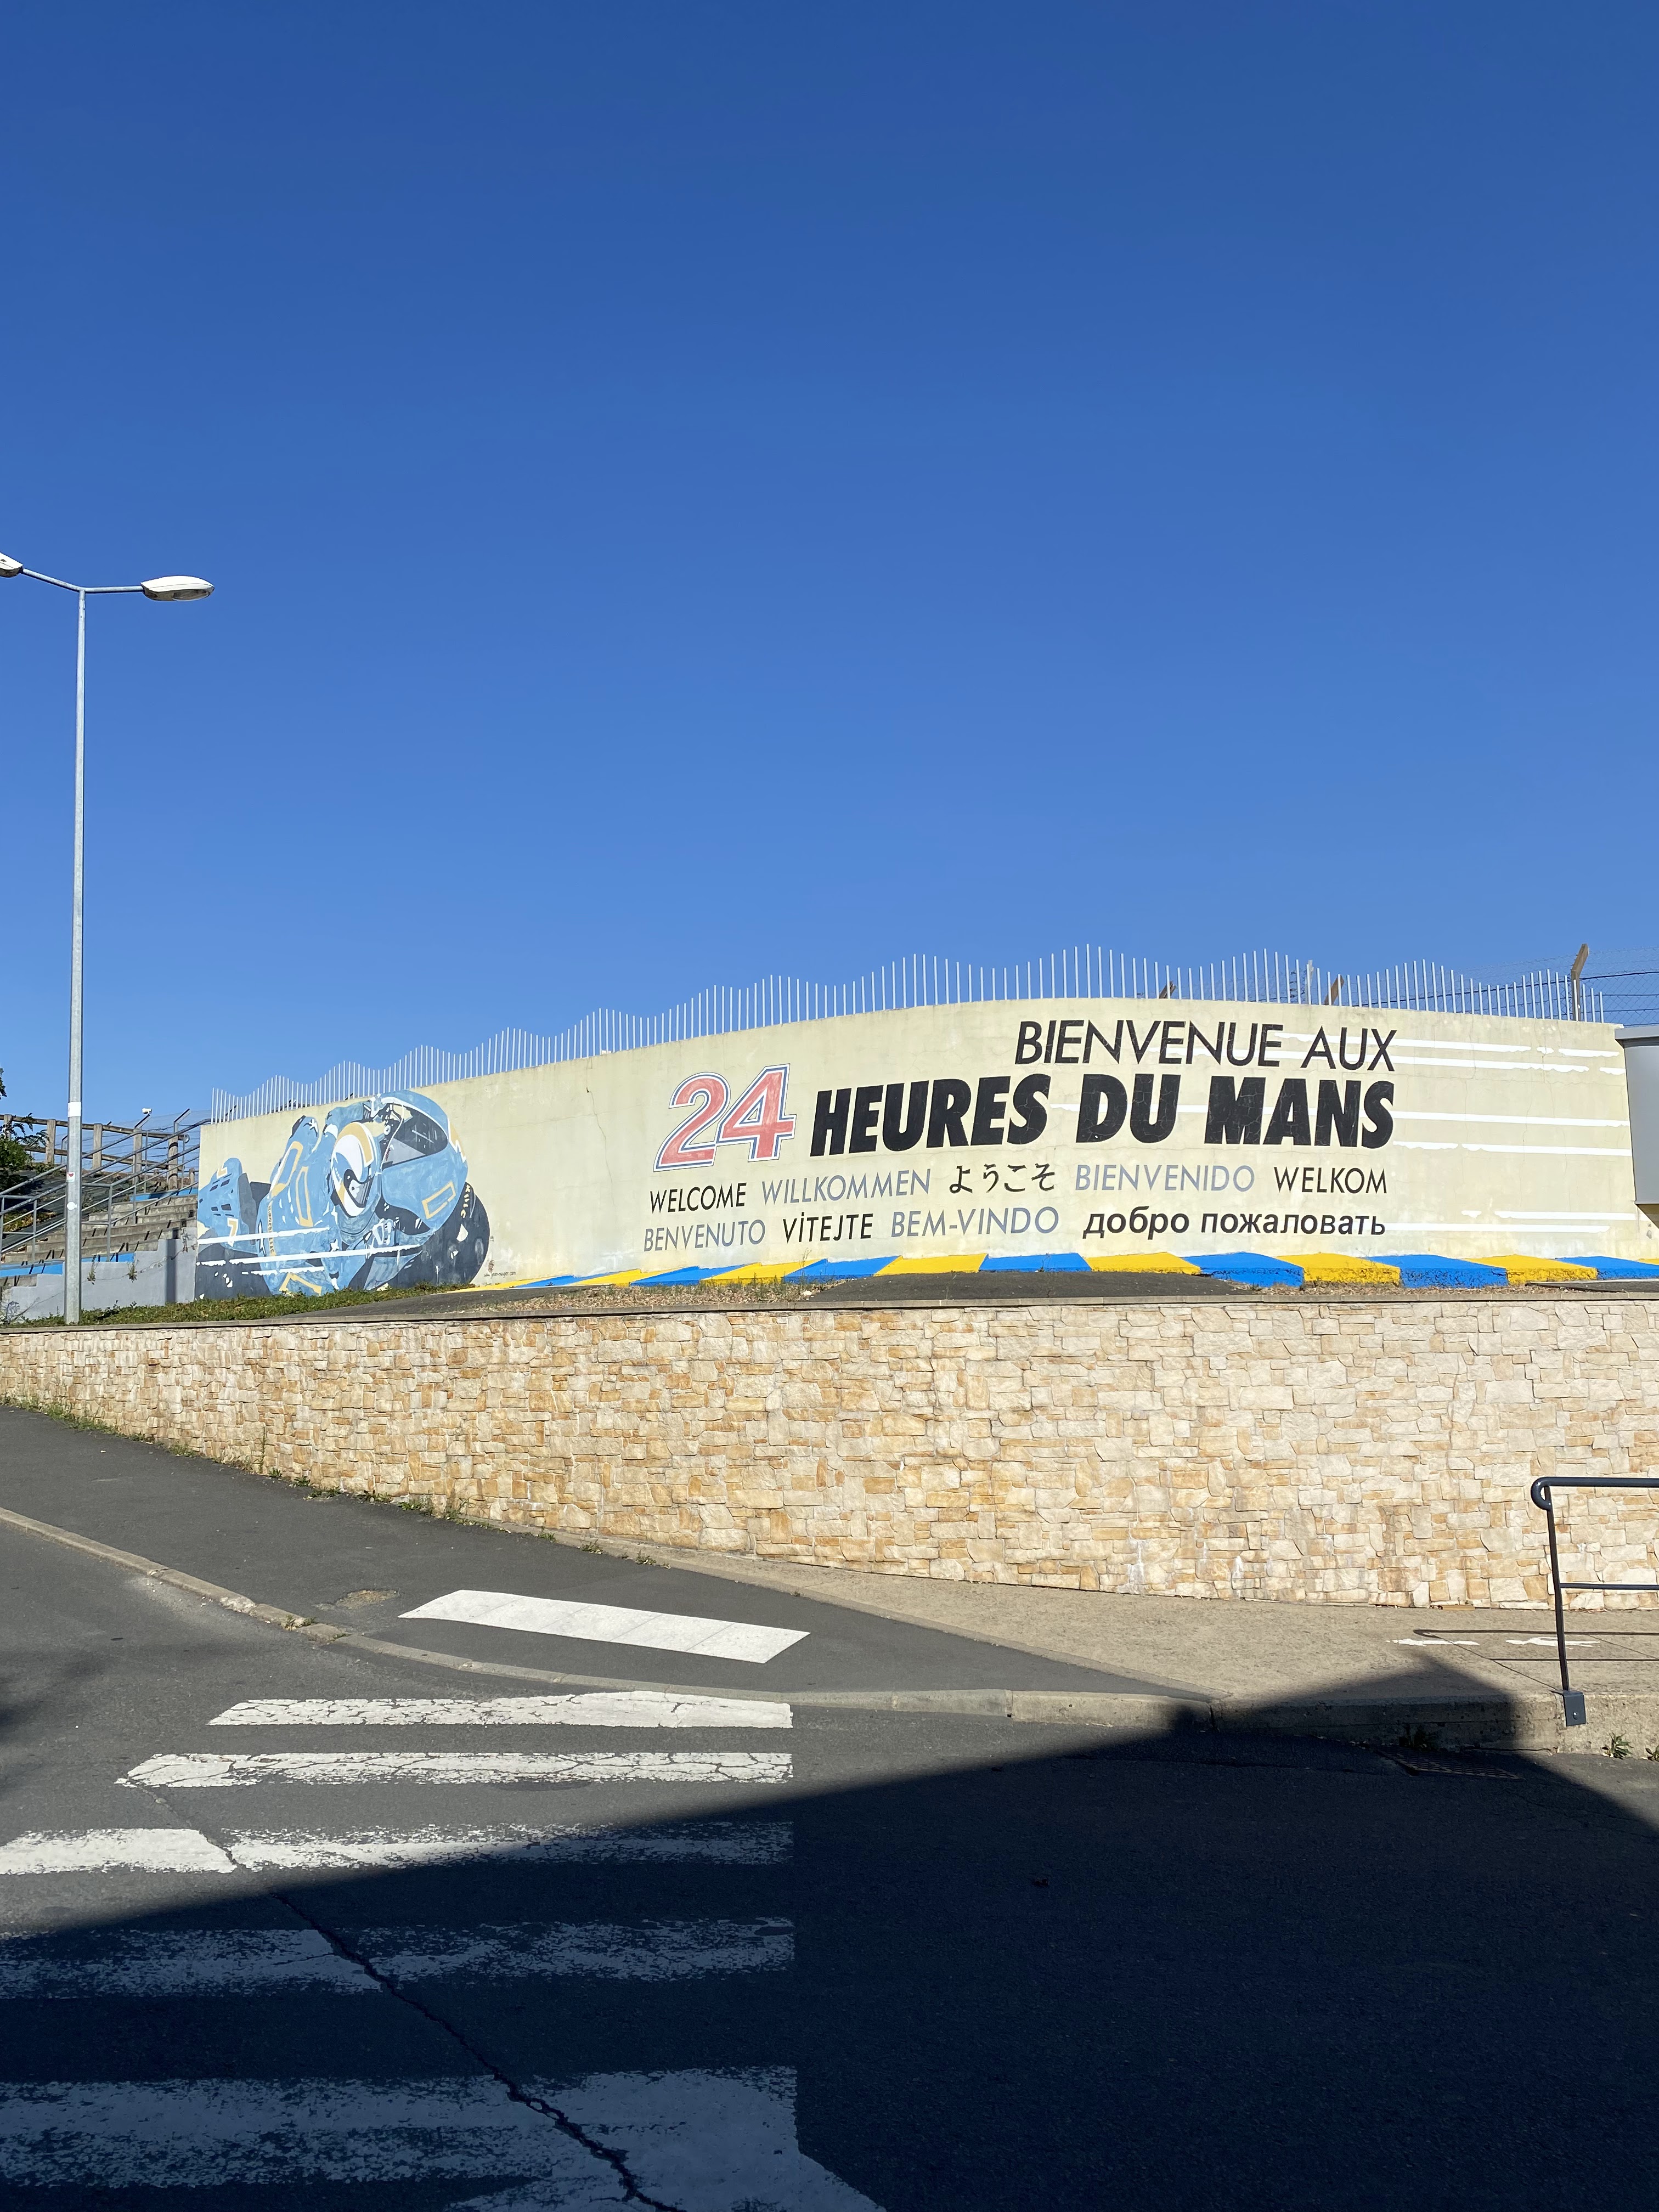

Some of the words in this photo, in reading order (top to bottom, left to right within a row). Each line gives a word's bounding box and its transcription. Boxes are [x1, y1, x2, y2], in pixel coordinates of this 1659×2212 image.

[1015, 1019, 1284, 1068] BIENVENUE
[1300, 1025, 1397, 1072] AUX
[653, 1064, 797, 1172] 24
[810, 1074, 1052, 1157] HEURES
[1075, 1073, 1182, 1144] DU
[1204, 1076, 1395, 1149] MANS
[650, 1182, 747, 1214] WELCOME
[761, 1168, 931, 1205] WILLKOMMEN
[949, 1163, 1056, 1194] ようこそ
[1075, 1164, 1255, 1192] BIENVENIDO
[1273, 1166, 1387, 1194] WELKOM
[644, 1219, 765, 1252] BENVENUTO
[891, 1206, 1059, 1238] BEM-VINDO
[1082, 1205, 1190, 1240] добро
[1200, 1213, 1386, 1235] пожаловать
